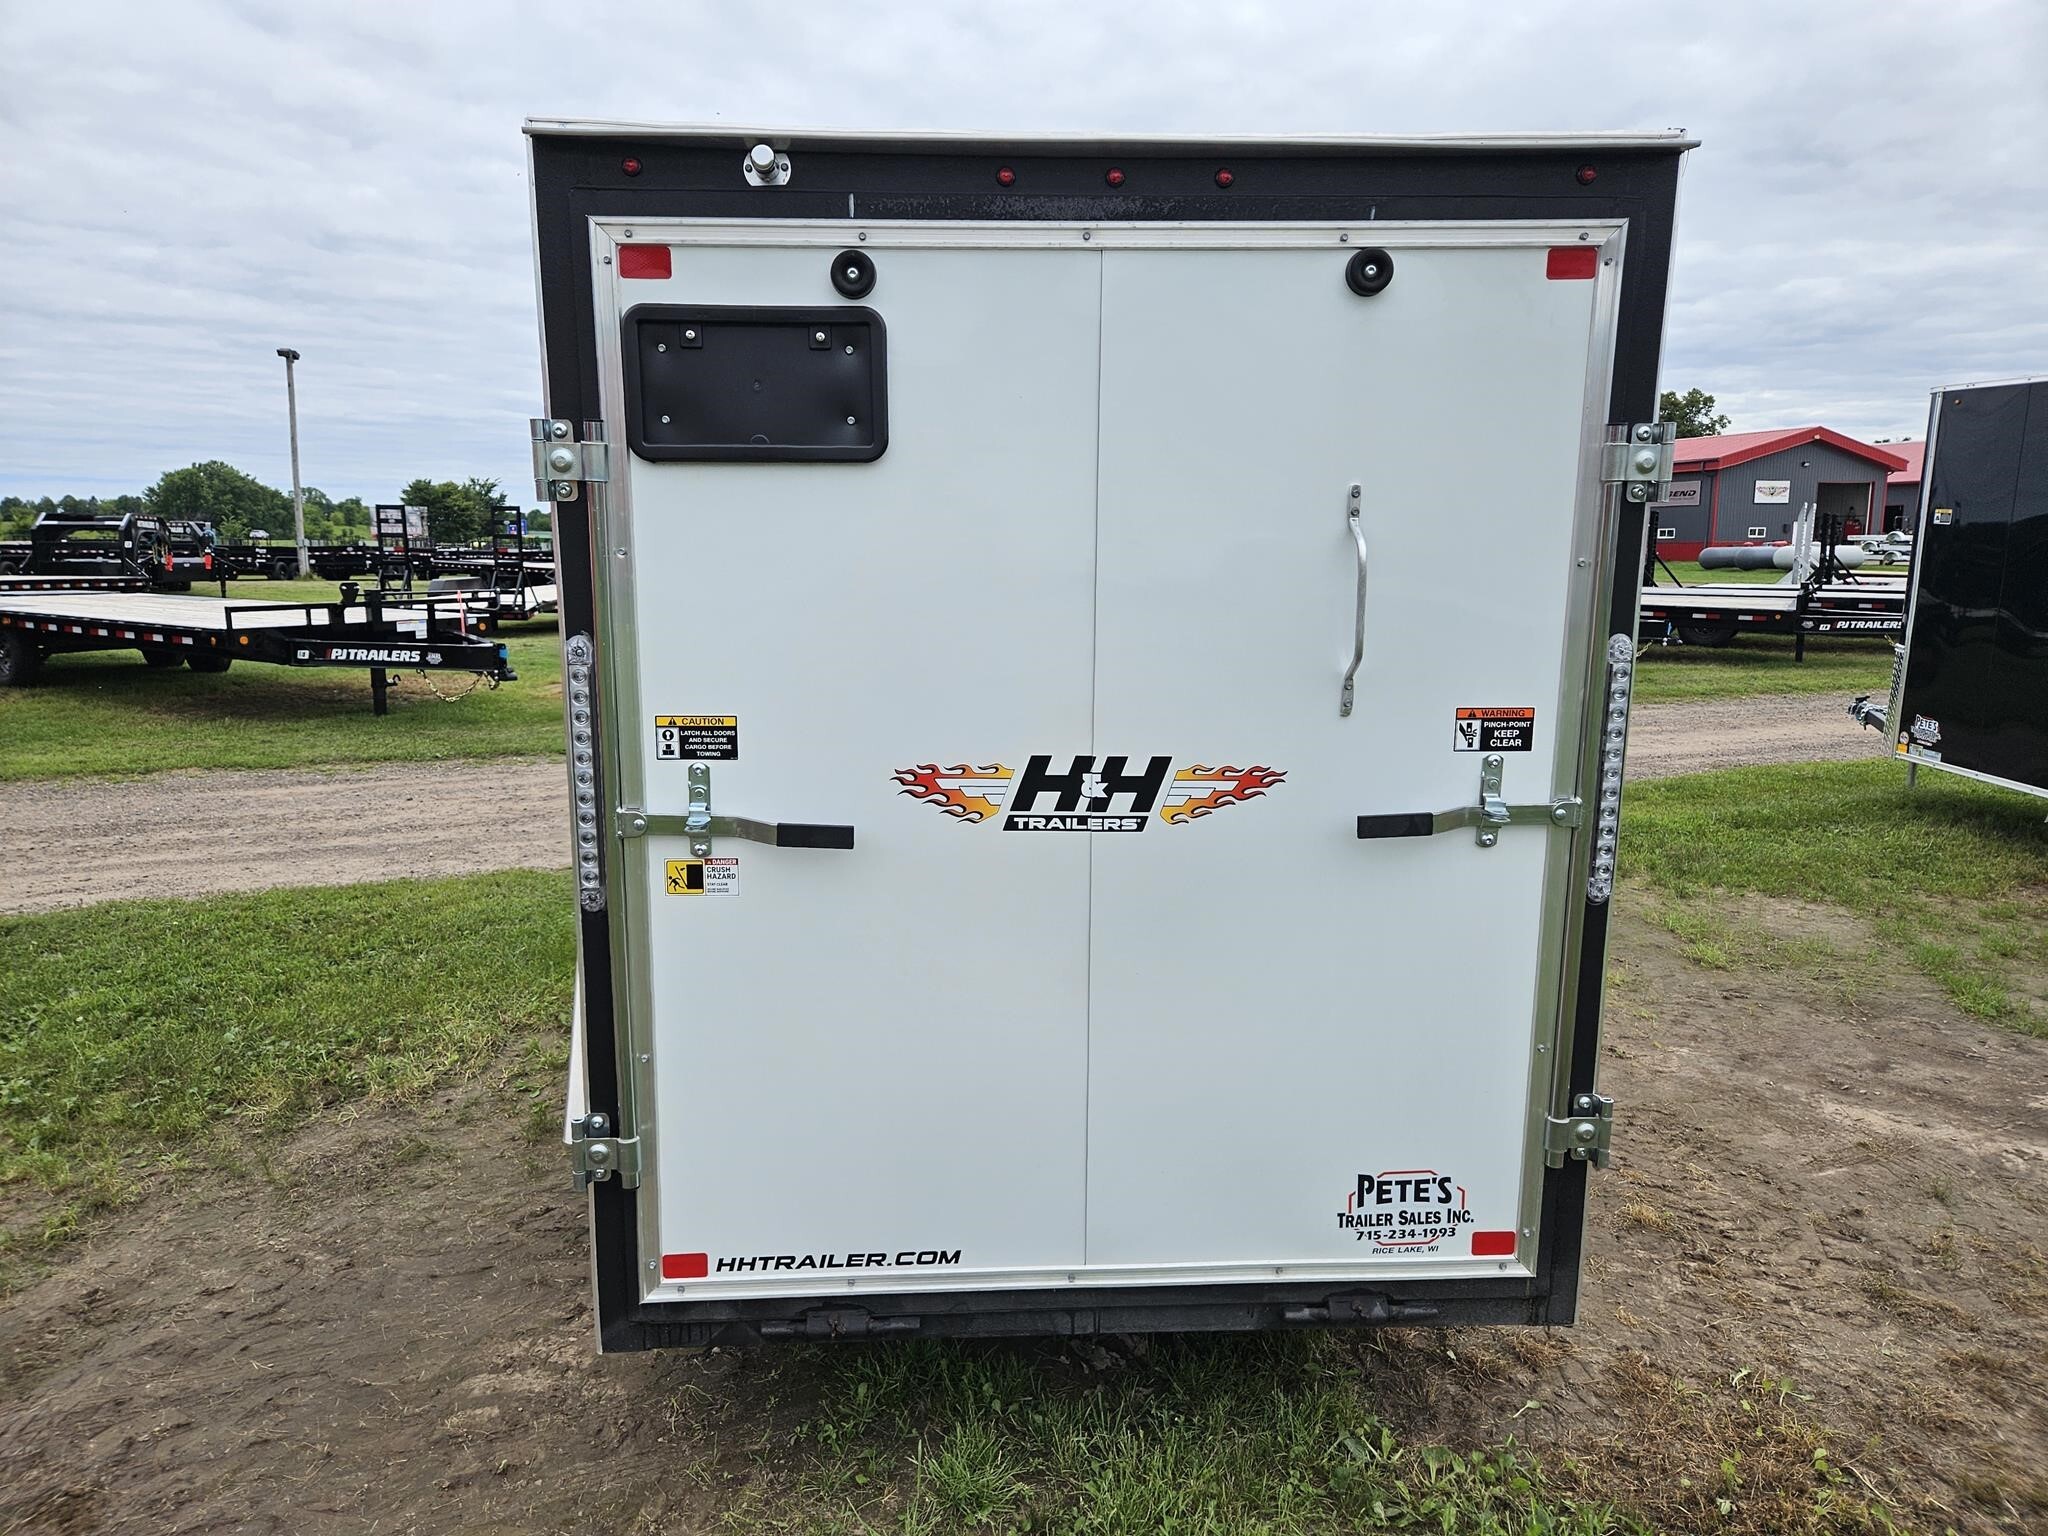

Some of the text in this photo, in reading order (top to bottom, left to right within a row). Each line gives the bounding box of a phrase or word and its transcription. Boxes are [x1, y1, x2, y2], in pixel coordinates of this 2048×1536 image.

[1481, 709, 1525, 717] WARNING
[681, 717, 725, 725] CAUTION
[1493, 729, 1520, 738] KEEP
[1489, 738, 1522, 747] CLEAR
[1009, 754, 1173, 813] H&H
[1013, 817, 1138, 830] TRAILERS
[1356, 1173, 1453, 1208] PETE'S
[1336, 1208, 1475, 1228] TRAILER SALES INC.
[1356, 1227, 1456, 1241] 715-234-1993
[1397, 1246, 1425, 1254] LAKE,
[715, 1250, 962, 1272] HHTRAILER.COM
